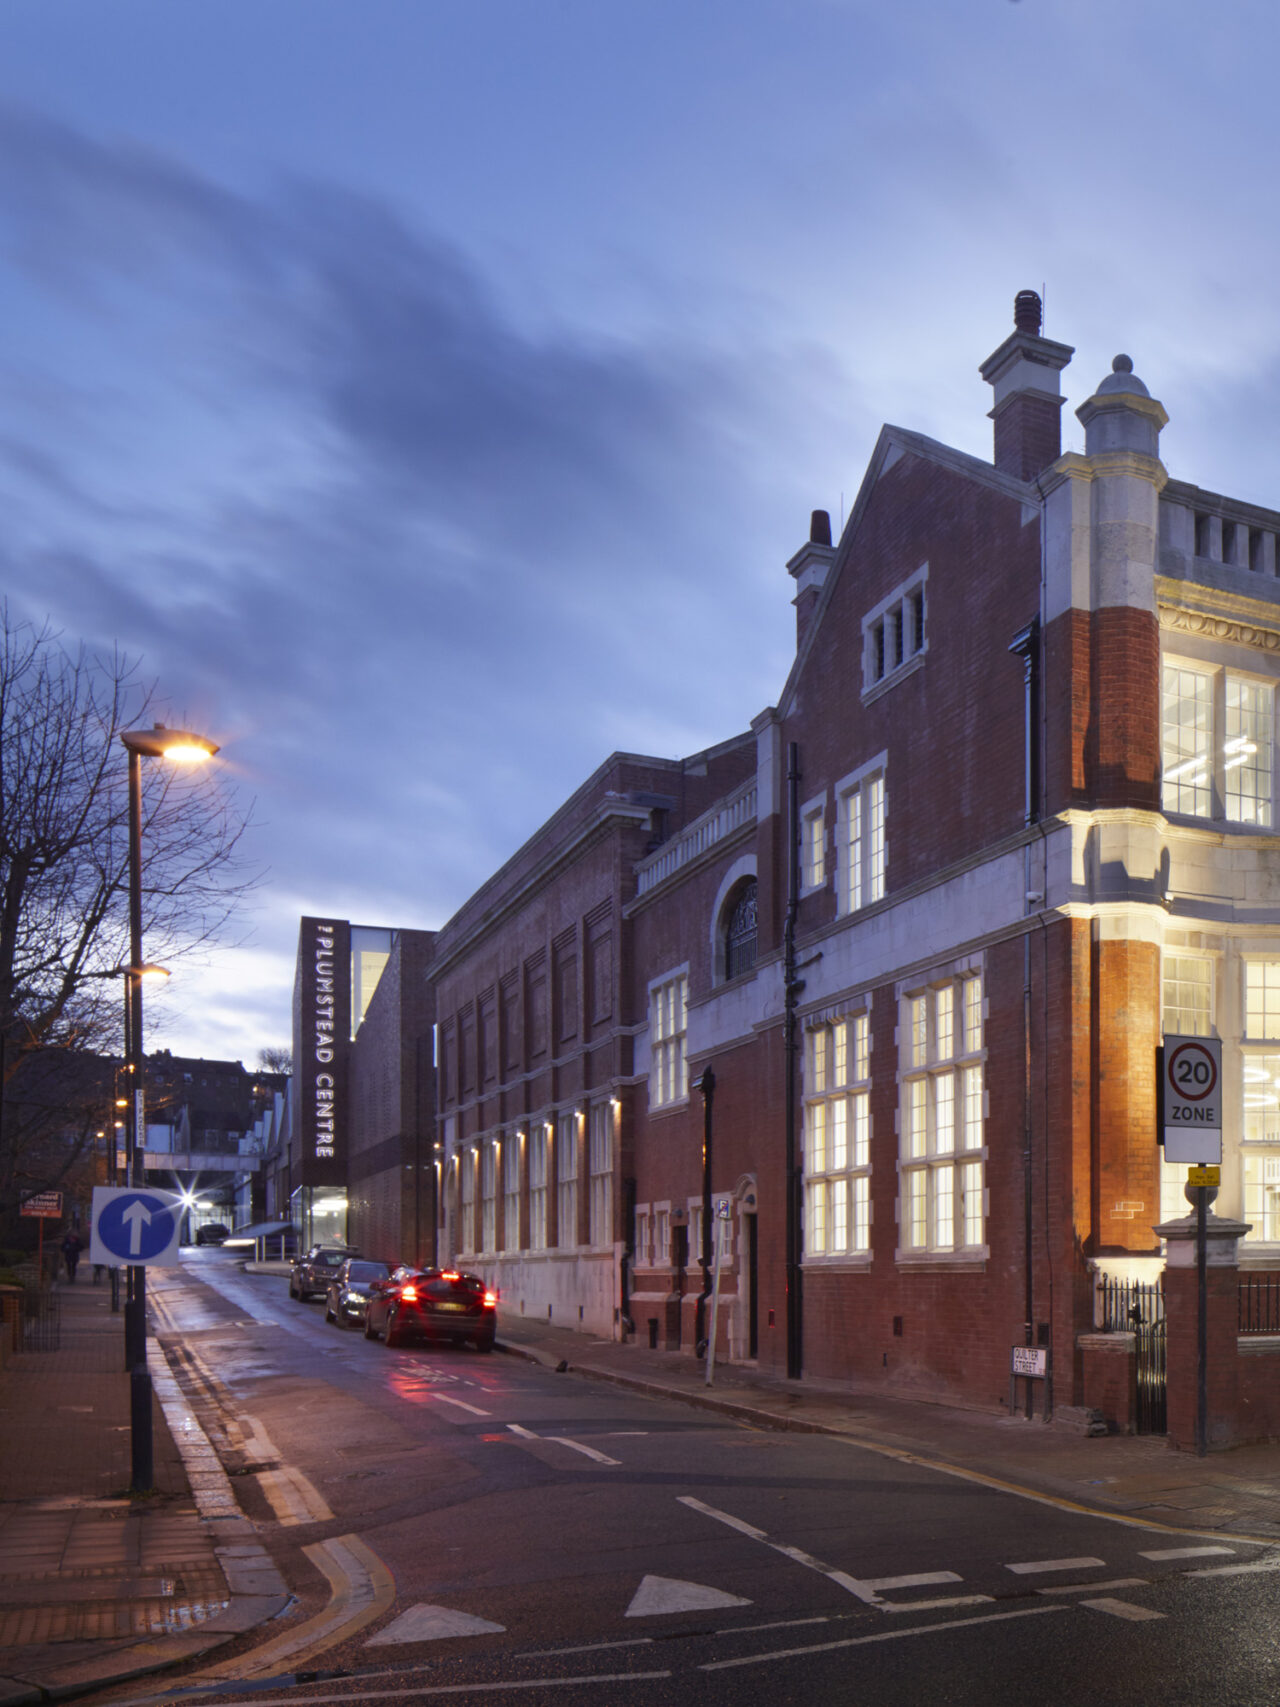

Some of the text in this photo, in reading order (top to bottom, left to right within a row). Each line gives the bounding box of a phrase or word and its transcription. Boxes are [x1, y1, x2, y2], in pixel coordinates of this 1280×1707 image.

[316, 937, 334, 1063] PLUMSTEAD
[1177, 1060, 1210, 1084] 20
[316, 1072, 334, 1158] CENTRE
[1172, 1106, 1214, 1121] ZONE
[1015, 1348, 1038, 1361] QUILTER
[1015, 1360, 1037, 1373] STREET
